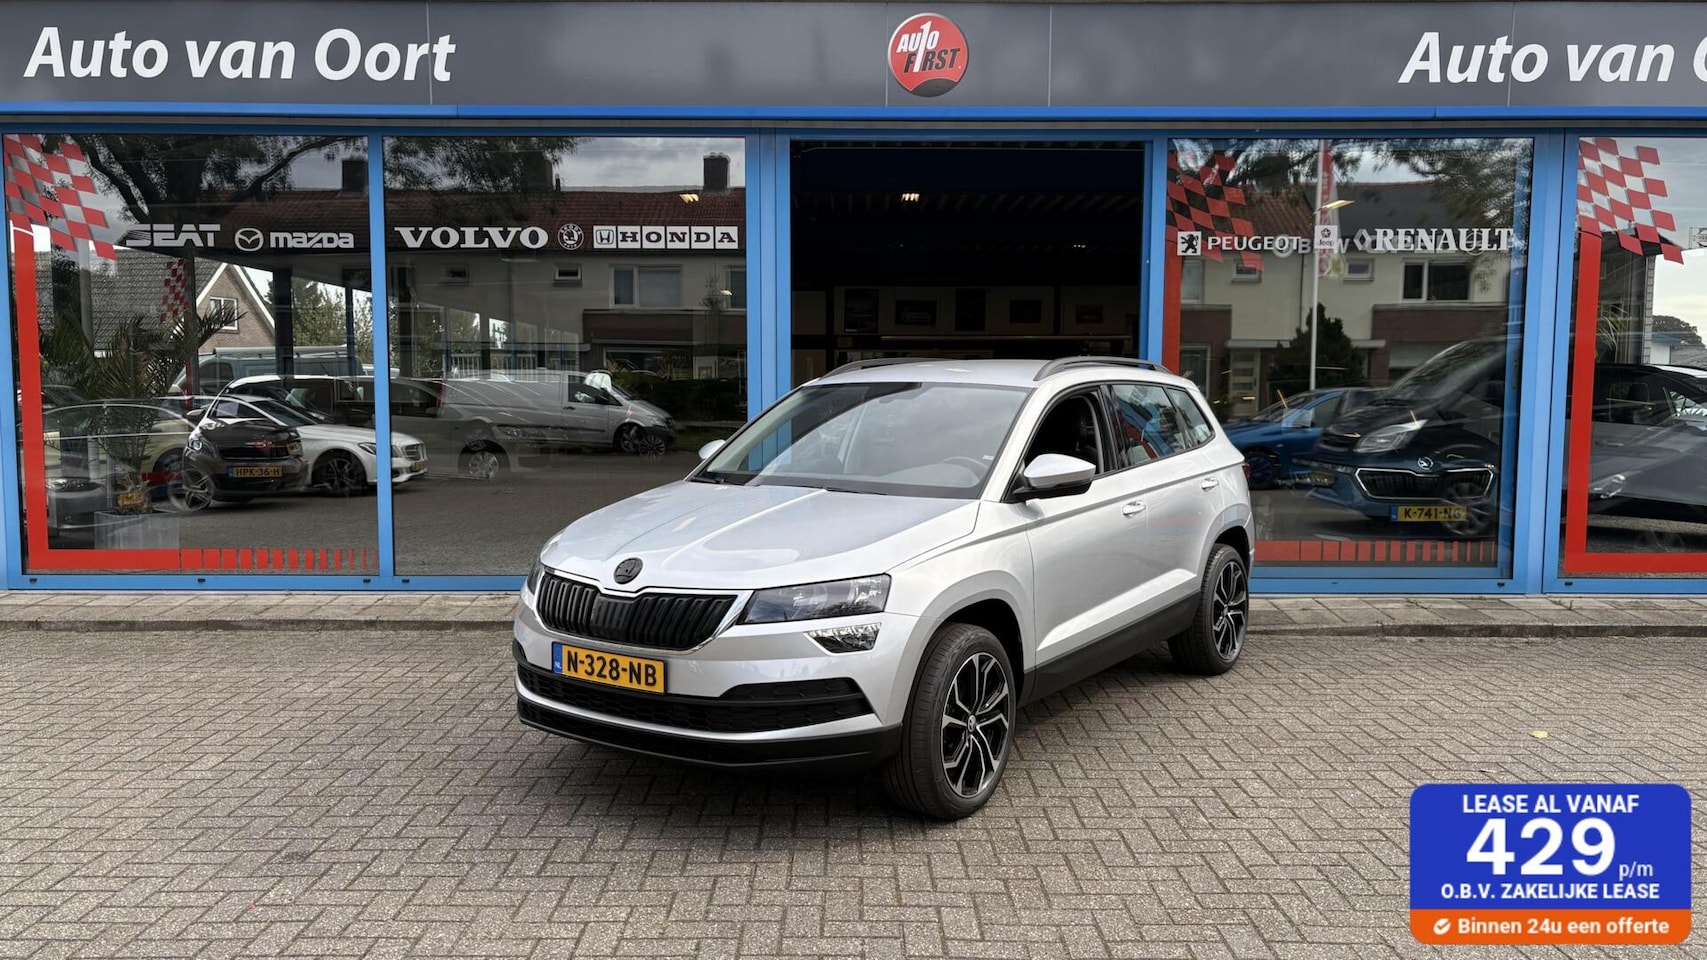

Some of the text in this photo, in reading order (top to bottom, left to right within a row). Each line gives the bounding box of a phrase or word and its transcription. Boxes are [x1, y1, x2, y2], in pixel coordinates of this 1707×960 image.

[24, 26, 457, 82] Auto van Oort
[1398, 31, 1549, 84] Auto
[1566, 43, 1675, 83] van
[126, 223, 221, 248] SEAT
[269, 231, 355, 249] mazda
[394, 226, 549, 249] VOLVO
[619, 230, 738, 244] HONDA
[1207, 235, 1302, 251] PEUGEOT
[1298, 237, 1350, 254] BW
[1374, 227, 1514, 251] RENAULT
[235, 465, 281, 477] HPK-36-H
[1403, 507, 1464, 520] K-741-NG
[567, 650, 657, 687] N-328-NB
